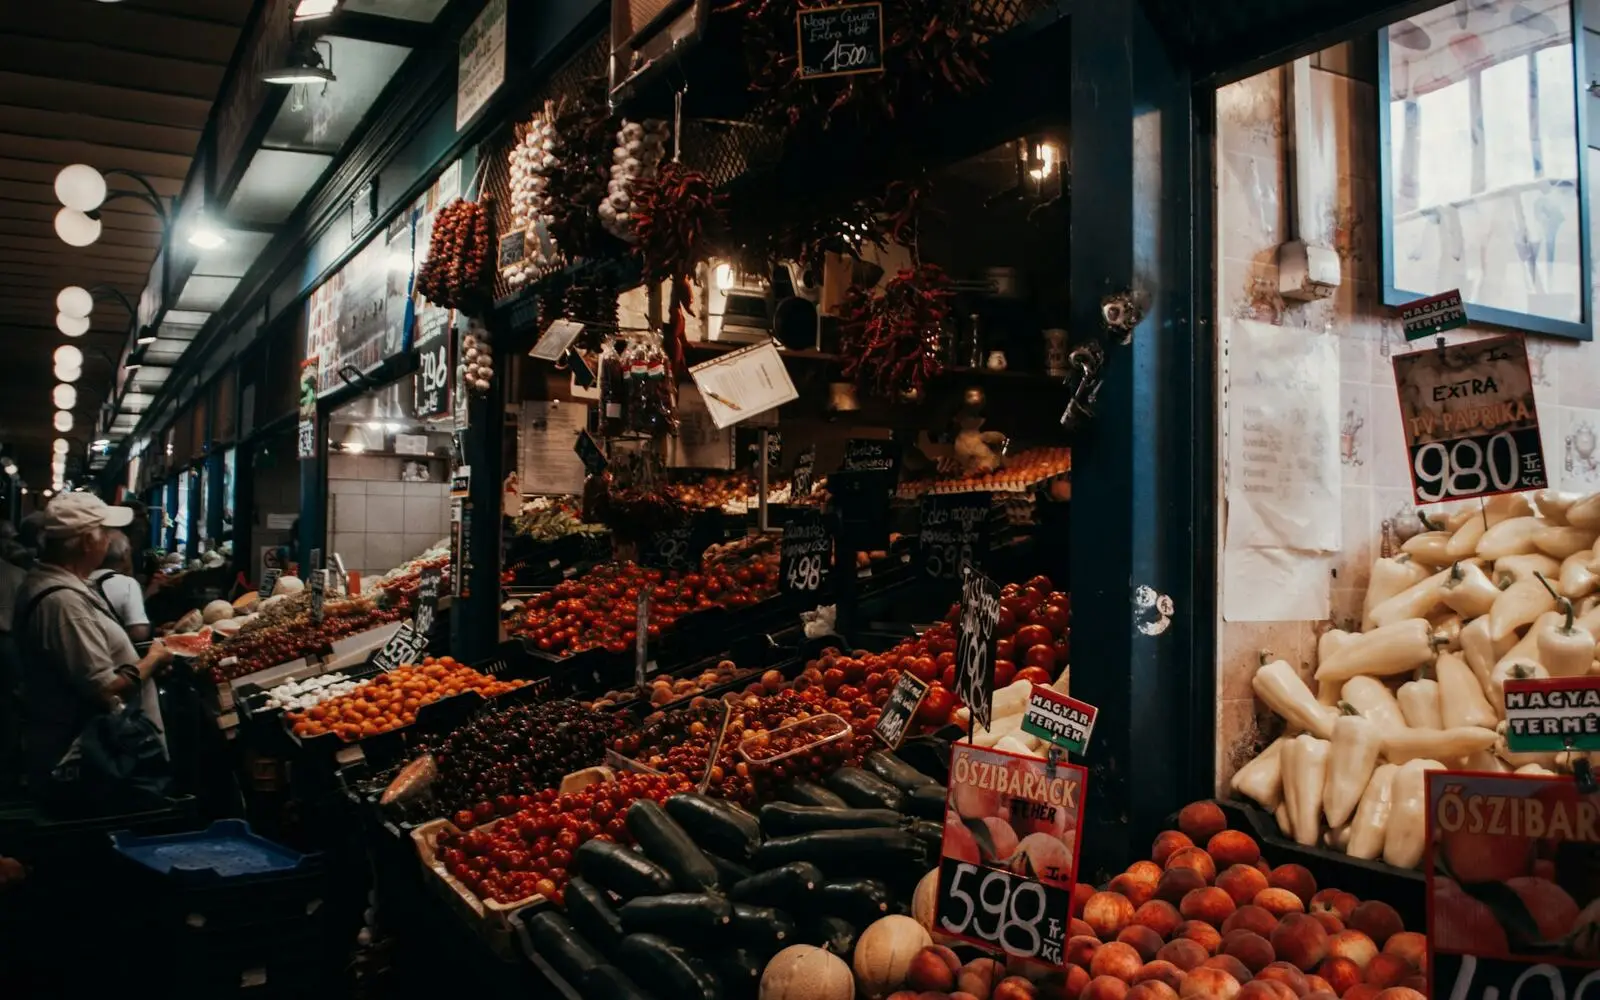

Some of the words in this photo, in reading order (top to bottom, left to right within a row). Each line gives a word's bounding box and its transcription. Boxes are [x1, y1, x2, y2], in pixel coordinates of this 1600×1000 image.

[823, 40, 866, 71] 1500
[1403, 297, 1459, 319] MAGYAR
[1432, 377, 1498, 401] EXTRA
[1410, 412, 1436, 437] TV
[1443, 402, 1531, 431] PAPRIKA
[1414, 432, 1519, 502] 980
[1032, 694, 1089, 725] MAGYAR
[1506, 690, 1600, 708] MAGYA
[1029, 711, 1082, 741] TERMÉK
[1511, 713, 1600, 735] TERMÉ
[955, 752, 1077, 808] ŐSZIBARACK
[1437, 783, 1600, 841] ŐSZIBAR
[941, 863, 1046, 958] 598
